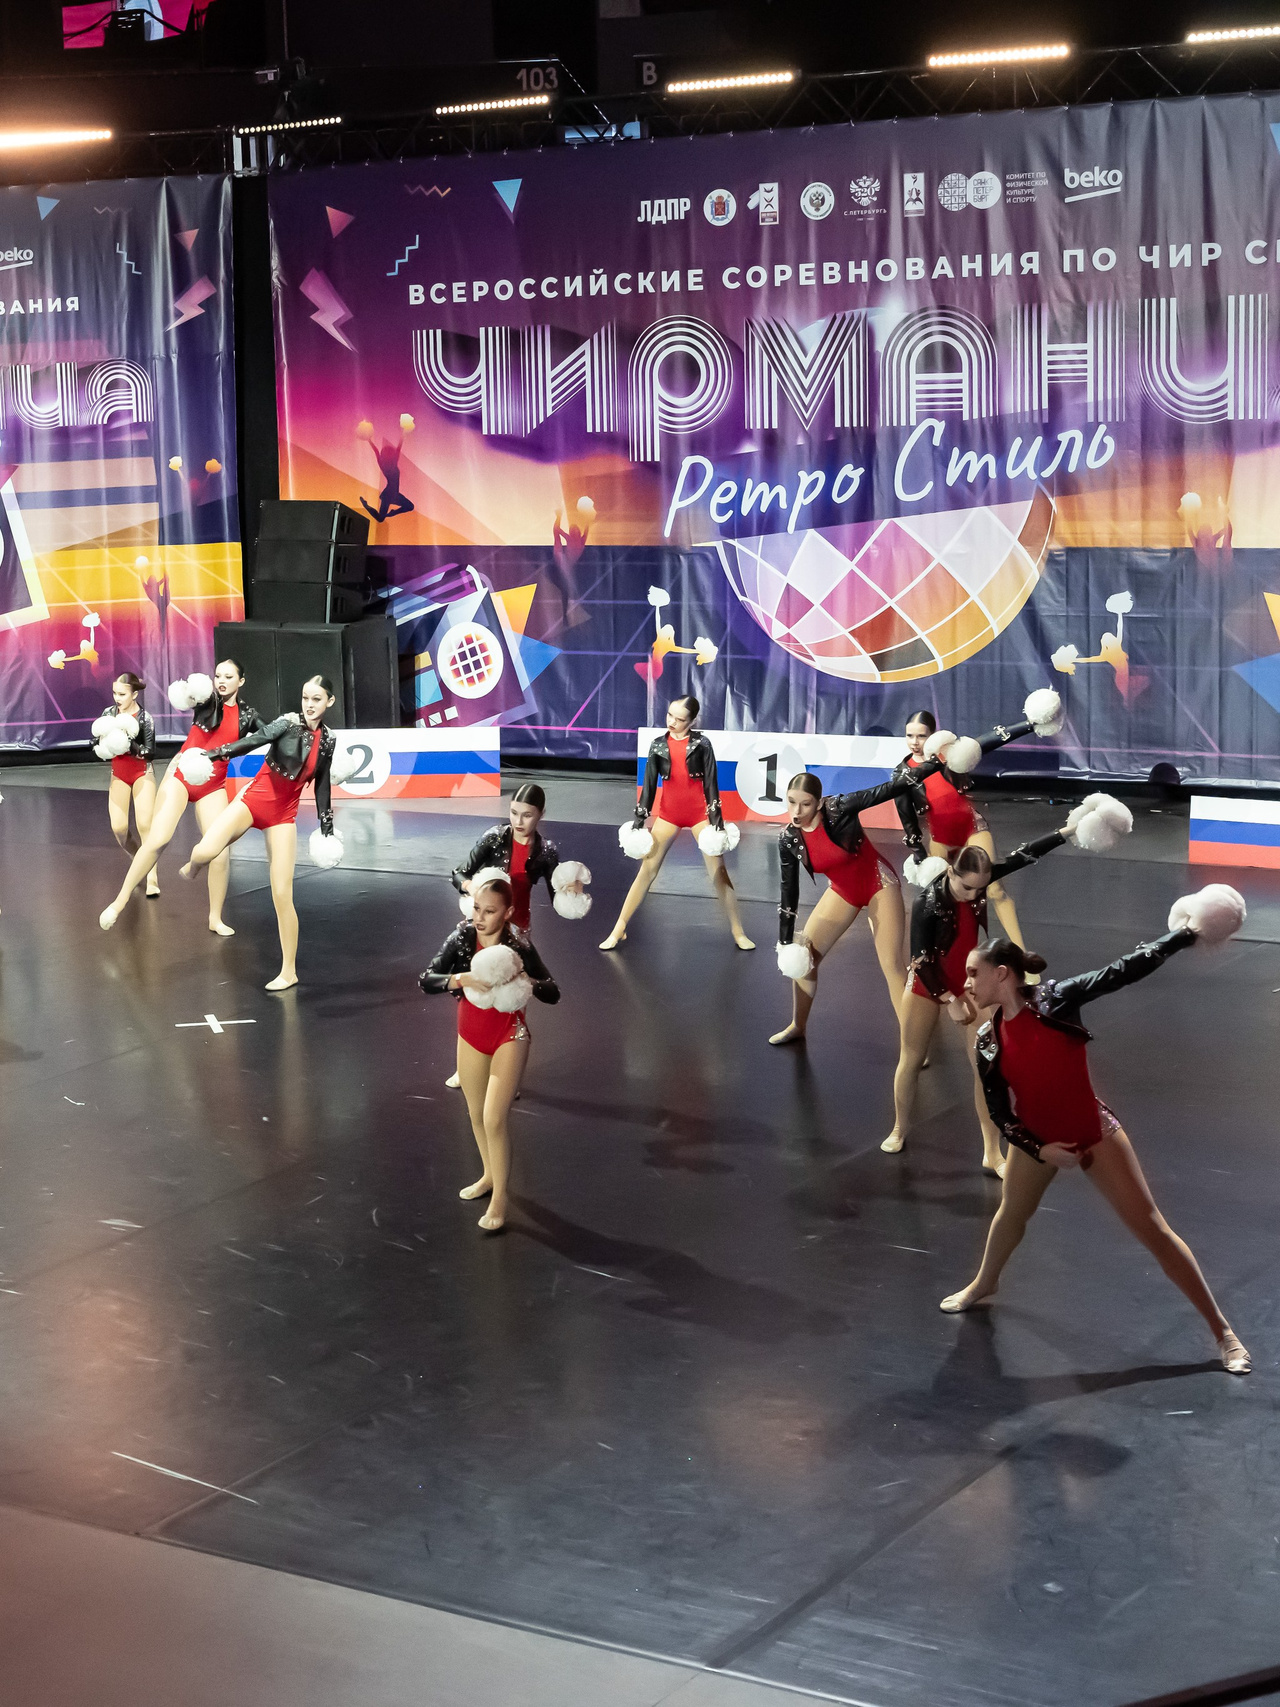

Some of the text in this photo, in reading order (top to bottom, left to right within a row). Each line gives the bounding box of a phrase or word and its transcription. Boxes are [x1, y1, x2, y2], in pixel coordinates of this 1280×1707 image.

[516, 66, 559, 92] 103
[1006, 171, 1047, 180] КОМИТЕТ ПО
[1006, 178, 1049, 188] ФИЗИЧЕСКОЙ
[1064, 166, 1123, 189] beko
[1006, 188, 1035, 196] КУЛЬТУРЕ
[1012, 196, 1037, 204] СПОРТУ
[637, 197, 691, 225] ЛДПР
[408, 239, 1280, 306] ВСЕРОССИЙСКИЕ СОРЕВНОВАНИЯ ПО ЧИР С
[663, 417, 1116, 538] Ретро Стиль
[346, 743, 375, 784] 2
[758, 752, 783, 802] 1
